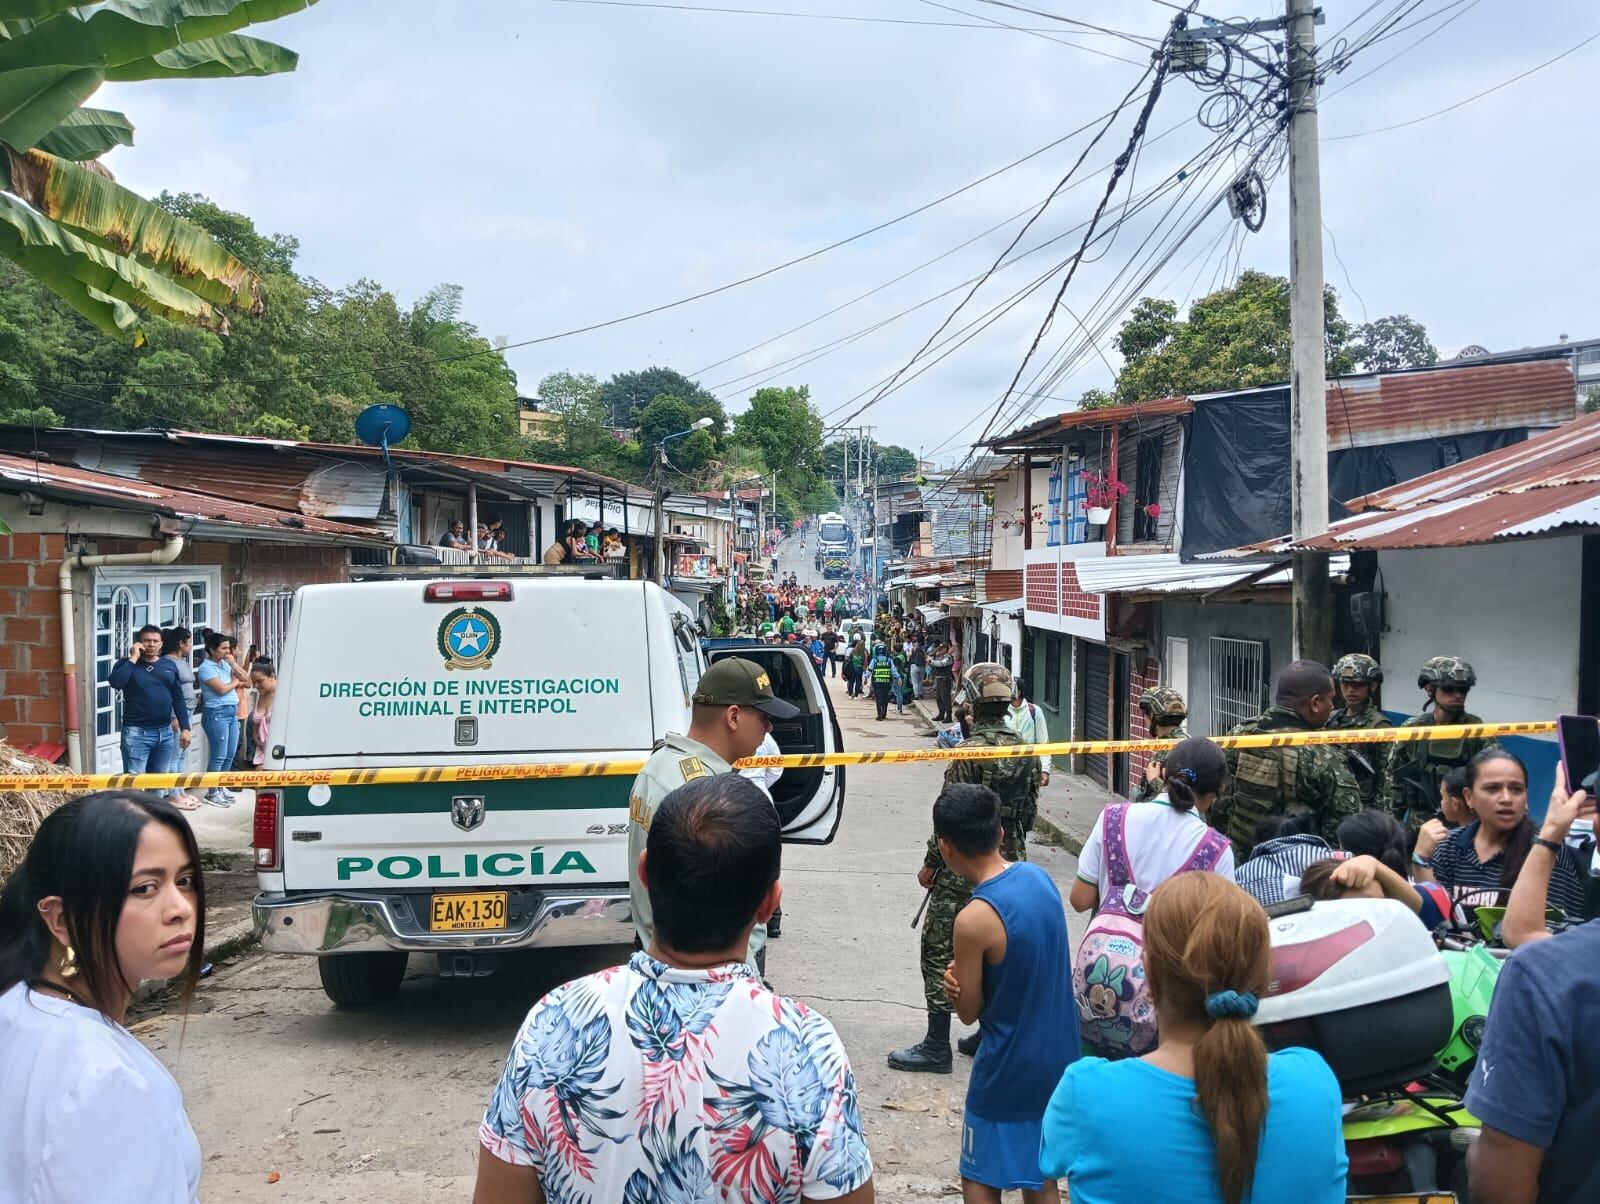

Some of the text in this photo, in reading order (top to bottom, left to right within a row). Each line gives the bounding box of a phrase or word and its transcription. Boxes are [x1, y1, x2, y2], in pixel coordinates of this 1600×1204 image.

[585, 500, 621, 514] Digndad
[319, 677, 619, 698] DIRECCIÓN DE INVESTIGACION
[359, 698, 577, 717] CRIMINAL E INTERPOL
[735, 756, 784, 767] NO PASE
[456, 766, 510, 777] PELIGRO
[514, 765, 531, 775] NO
[586, 823, 630, 835] 4X
[337, 846, 597, 881] POLICÍA
